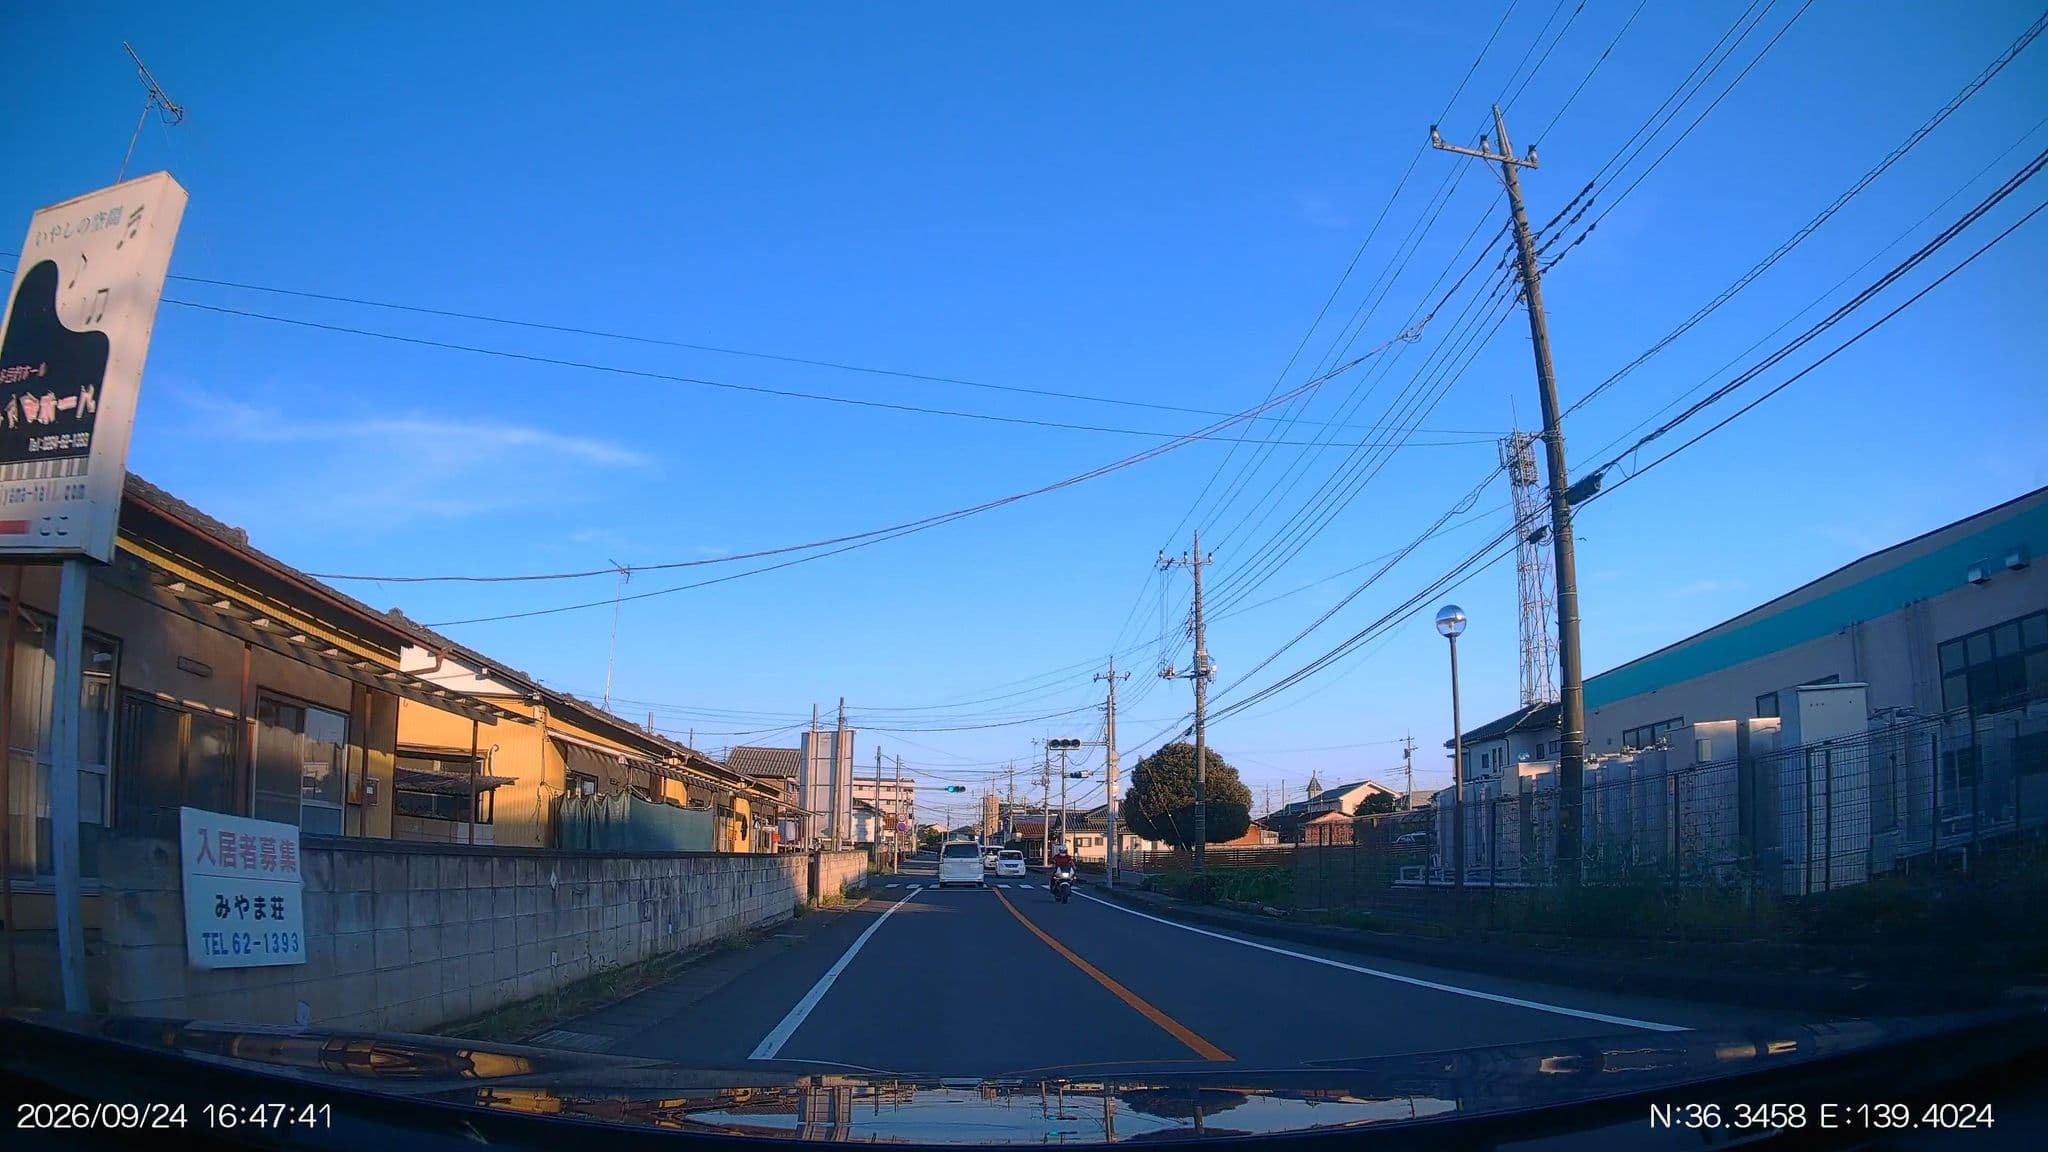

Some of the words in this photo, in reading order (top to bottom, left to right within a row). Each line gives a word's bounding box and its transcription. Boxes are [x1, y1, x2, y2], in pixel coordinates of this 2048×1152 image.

[196, 827, 297, 873] 入居者募集
[215, 894, 284, 921] みやま荘
